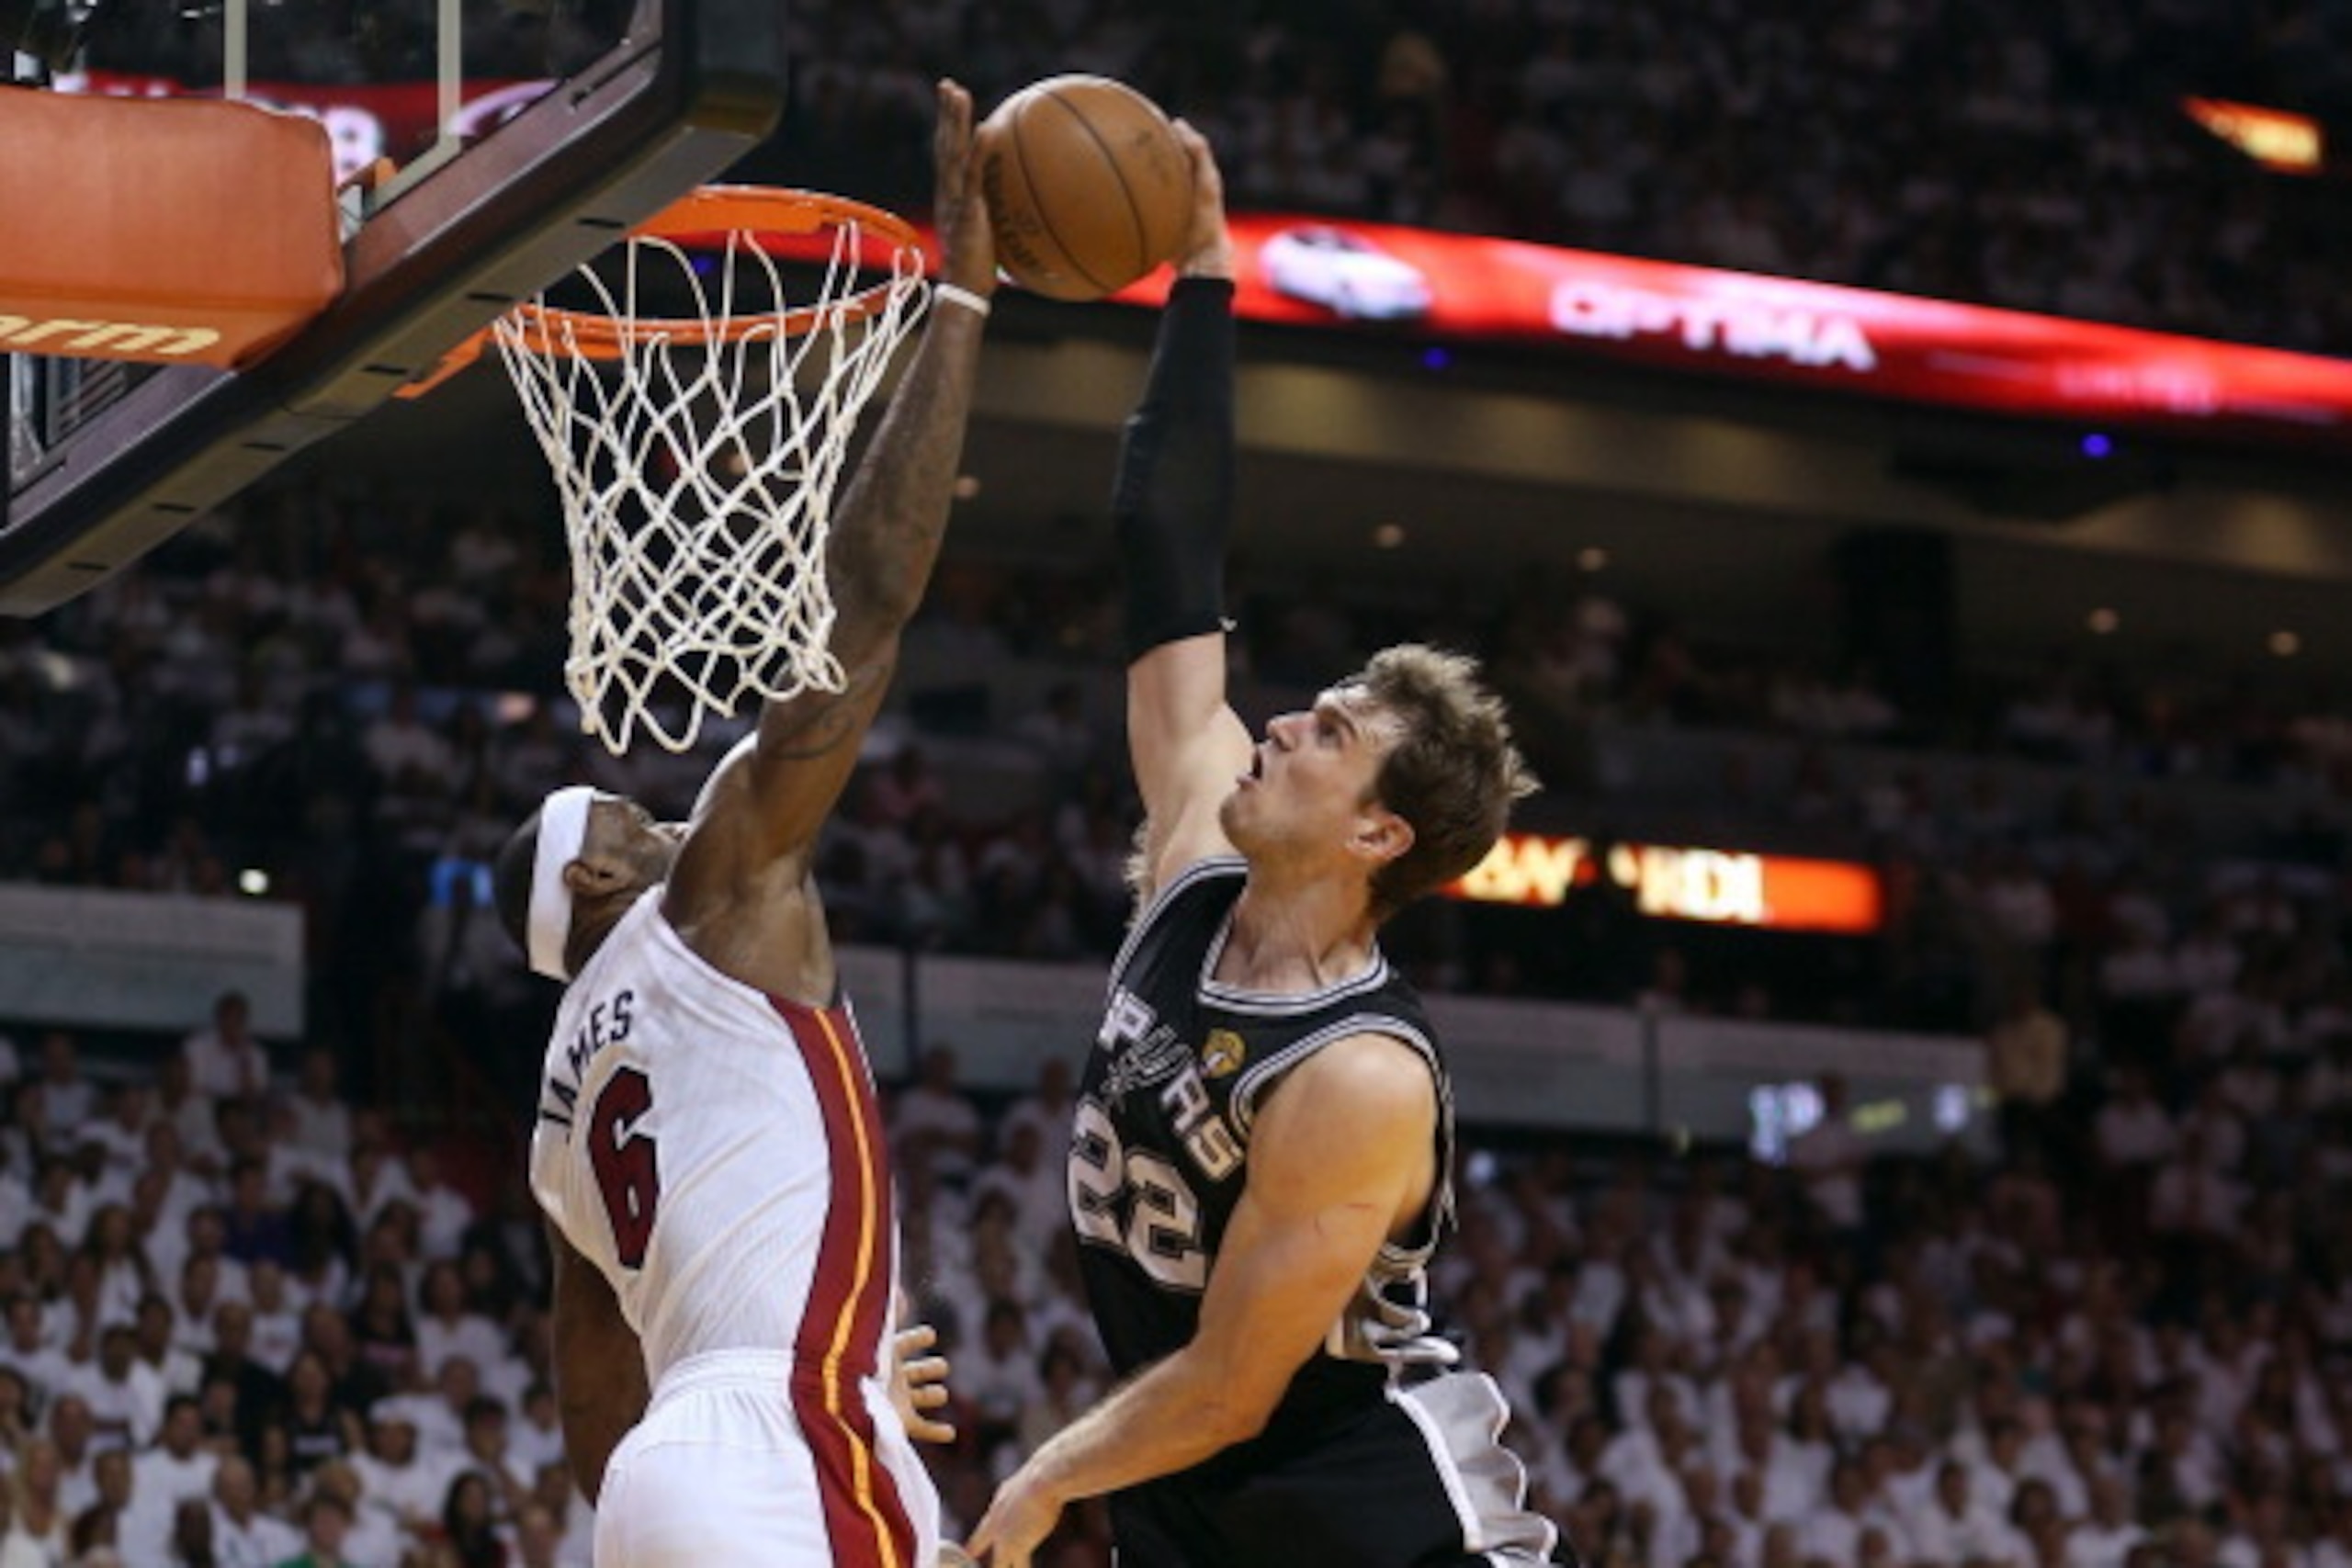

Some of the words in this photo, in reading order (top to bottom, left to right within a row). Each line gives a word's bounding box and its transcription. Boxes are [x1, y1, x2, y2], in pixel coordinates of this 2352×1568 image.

[0, 315, 220, 355] rm
[1550, 281, 1876, 373] OPTIMA
[539, 989, 634, 1145] JAMES
[1097, 986, 1243, 1181] PURS
[588, 1065, 660, 1270] 6
[1067, 1095, 1206, 1289] 22
